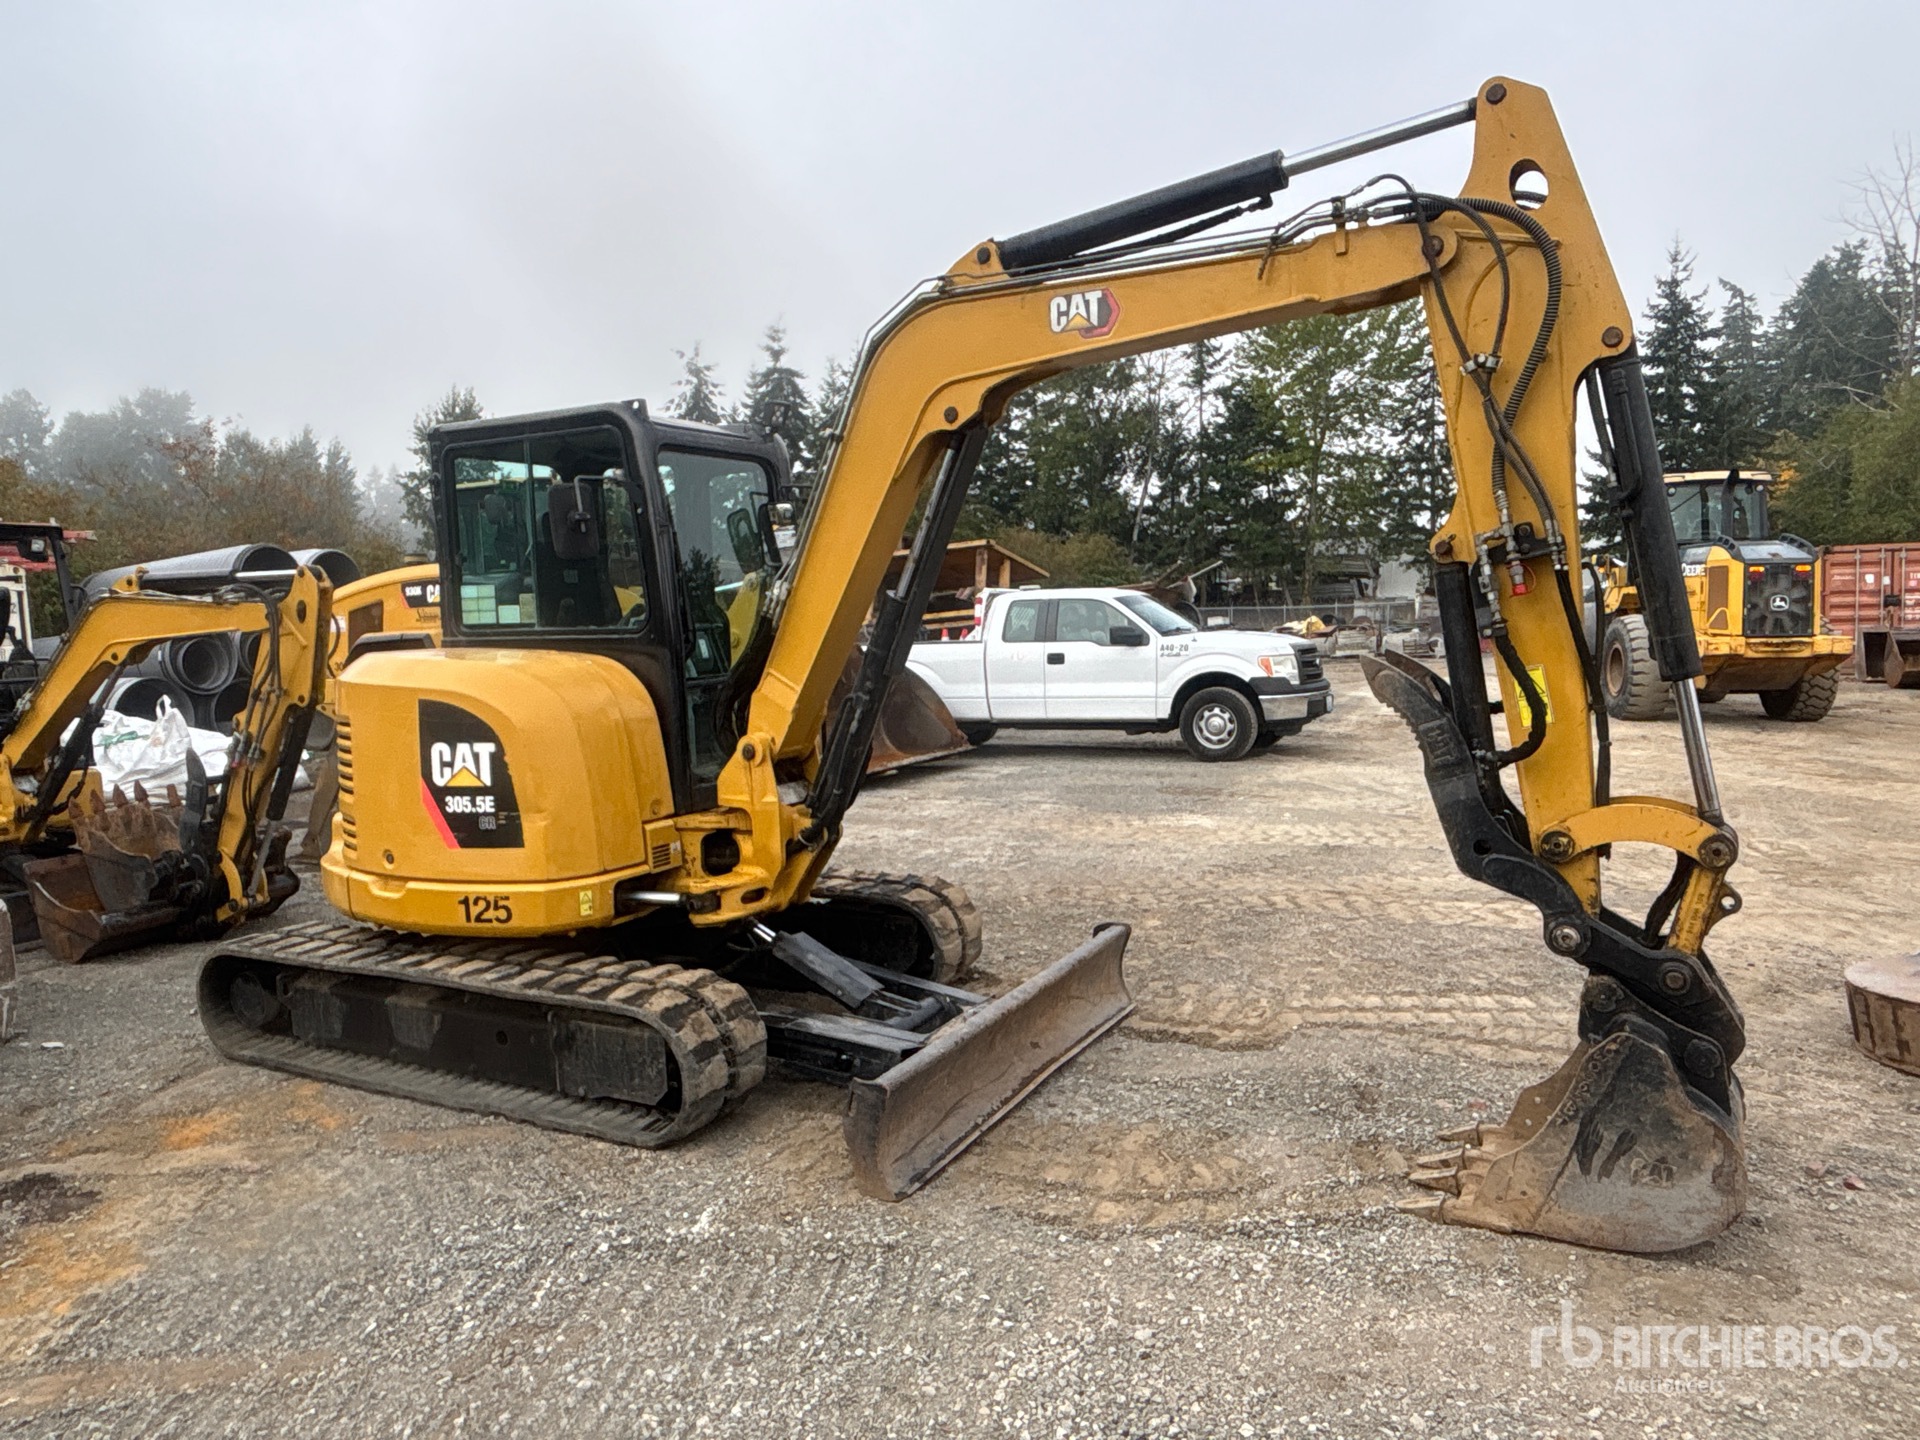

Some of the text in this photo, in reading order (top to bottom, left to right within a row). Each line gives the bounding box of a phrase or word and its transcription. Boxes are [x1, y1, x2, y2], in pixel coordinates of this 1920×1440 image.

[1050, 290, 1102, 332] CAT
[426, 584, 441, 603] CA
[430, 741, 496, 788] CAT
[444, 795, 496, 814] 305.5E
[458, 895, 513, 924] 125
